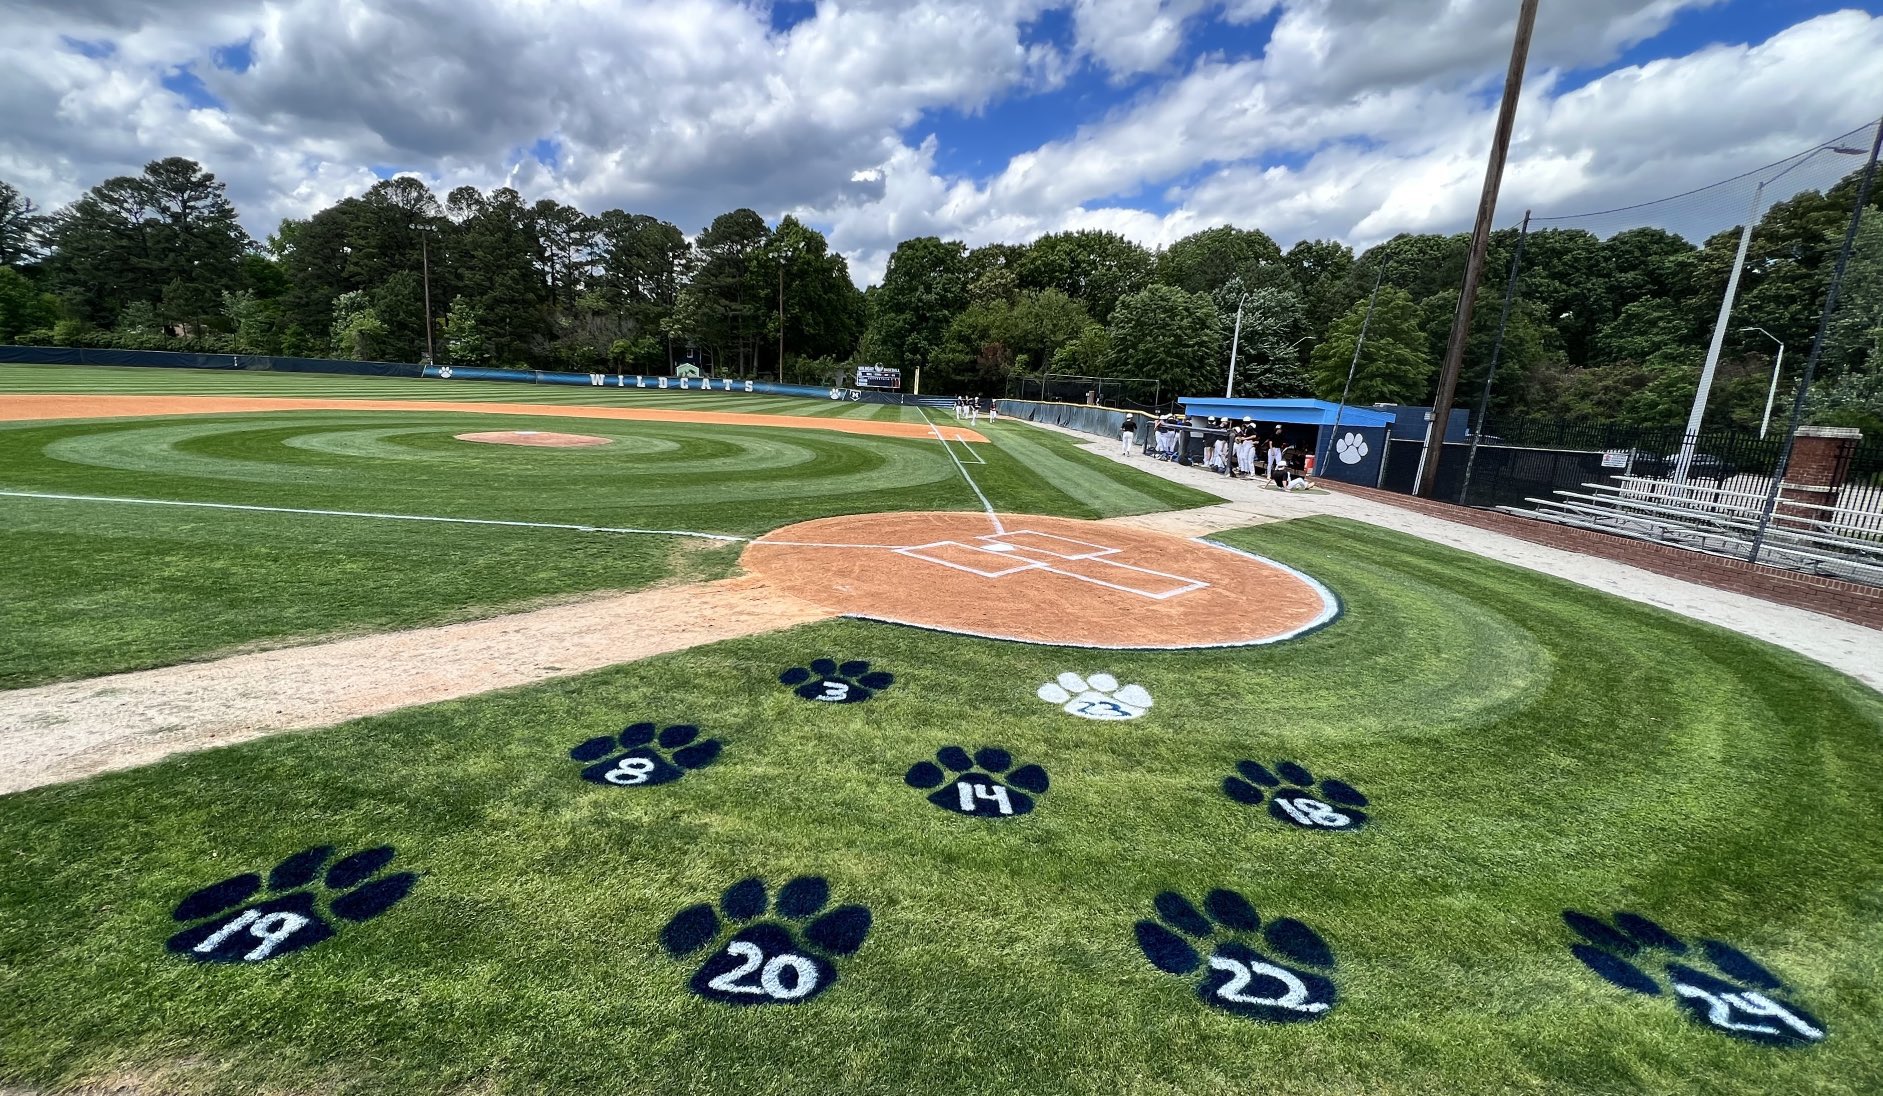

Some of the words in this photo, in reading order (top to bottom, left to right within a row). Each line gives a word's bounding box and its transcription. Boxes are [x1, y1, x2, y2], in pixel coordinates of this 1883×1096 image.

[590, 374, 753, 392] WILDCATS
[816, 681, 849, 702] 3
[604, 757, 655, 785] 8
[957, 781, 1013, 816] 14
[1274, 797, 1350, 829] 18
[194, 909, 309, 962] 19
[708, 941, 819, 1000] 20
[1207, 955, 1335, 1013] 22
[1673, 984, 1824, 1038] 24
